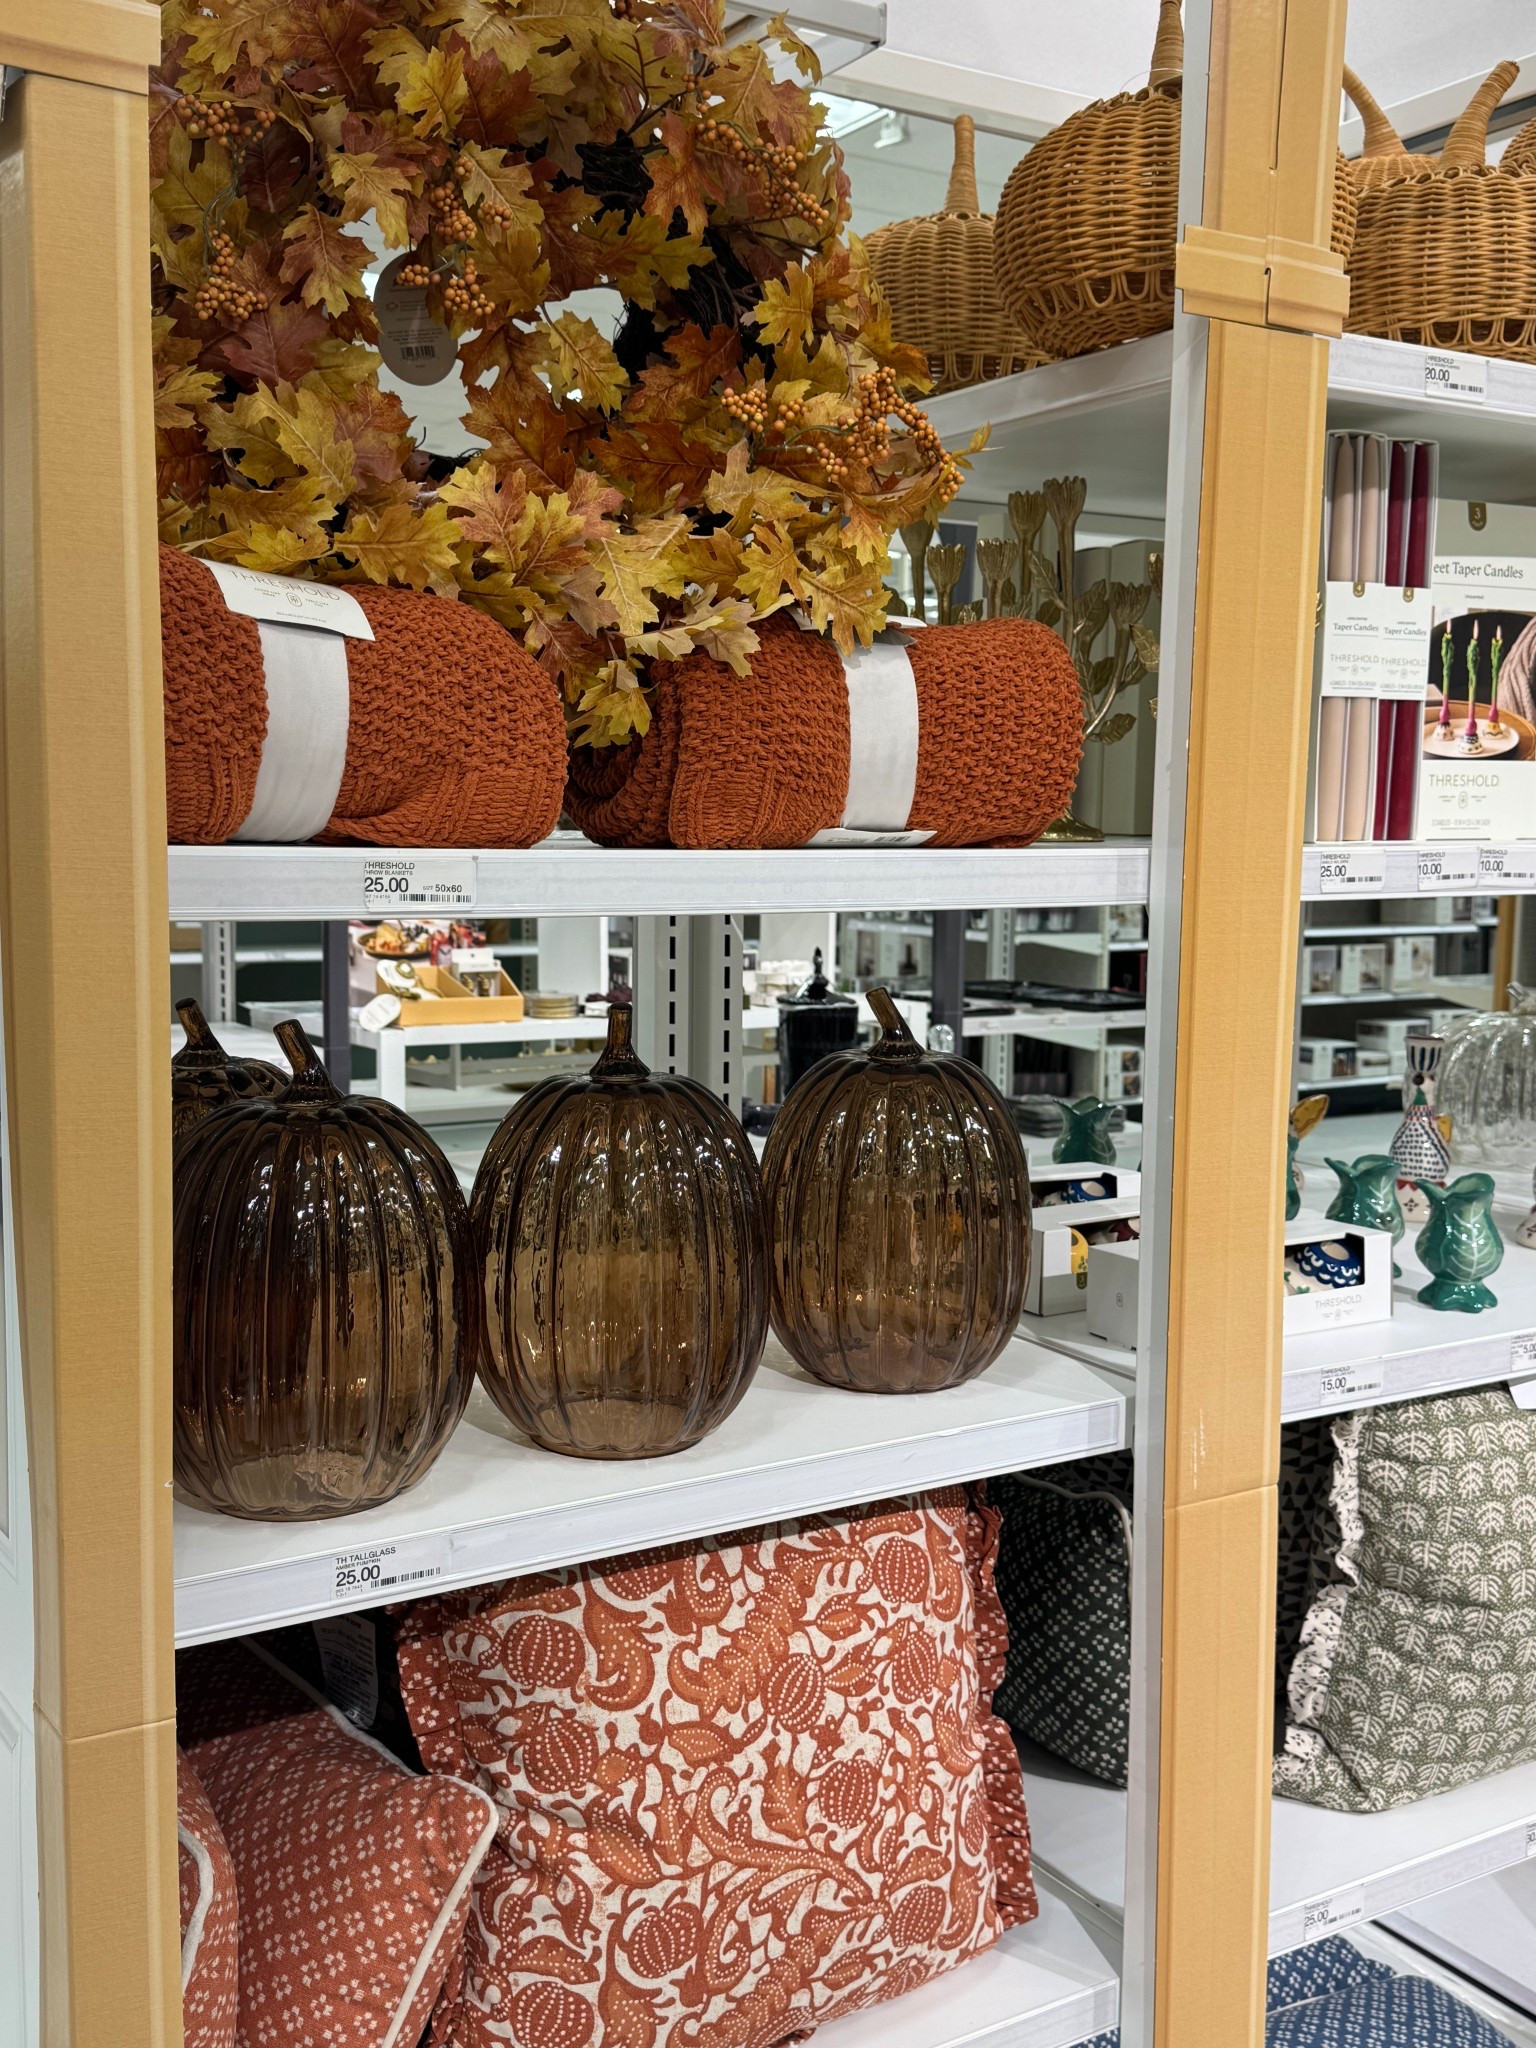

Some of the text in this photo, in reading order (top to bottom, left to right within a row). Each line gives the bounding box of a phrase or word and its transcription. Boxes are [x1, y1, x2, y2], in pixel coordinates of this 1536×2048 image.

[1425, 367, 1450, 382] 20.00
[1474, 507, 1481, 520] 3
[1433, 561, 1524, 579] eet Taper Candles
[229, 569, 341, 601] THRESHOLD
[1333, 622, 1379, 632] Taper Candles
[1384, 627, 1427, 636] Taper Candles
[1330, 654, 1379, 663] THRESHOLD
[1381, 657, 1427, 667] THRESHOLD
[1428, 774, 1500, 788] THRESHOLD
[1320, 865, 1347, 878] 25.00
[1418, 863, 1442, 876] 10.00
[1480, 860, 1504, 872] 10.00
[364, 876, 409, 893] 25.00
[435, 884, 463, 893] 50x60
[1315, 1294, 1362, 1310] THRESHOLD
[1321, 1377, 1347, 1392] 15.00
[335, 1546, 396, 1565] TH TALLGLASS
[335, 1557, 381, 1571] AMBER PUMPKIN
[335, 1564, 381, 1588] 25.00
[1304, 1909, 1329, 1927] 25.00
